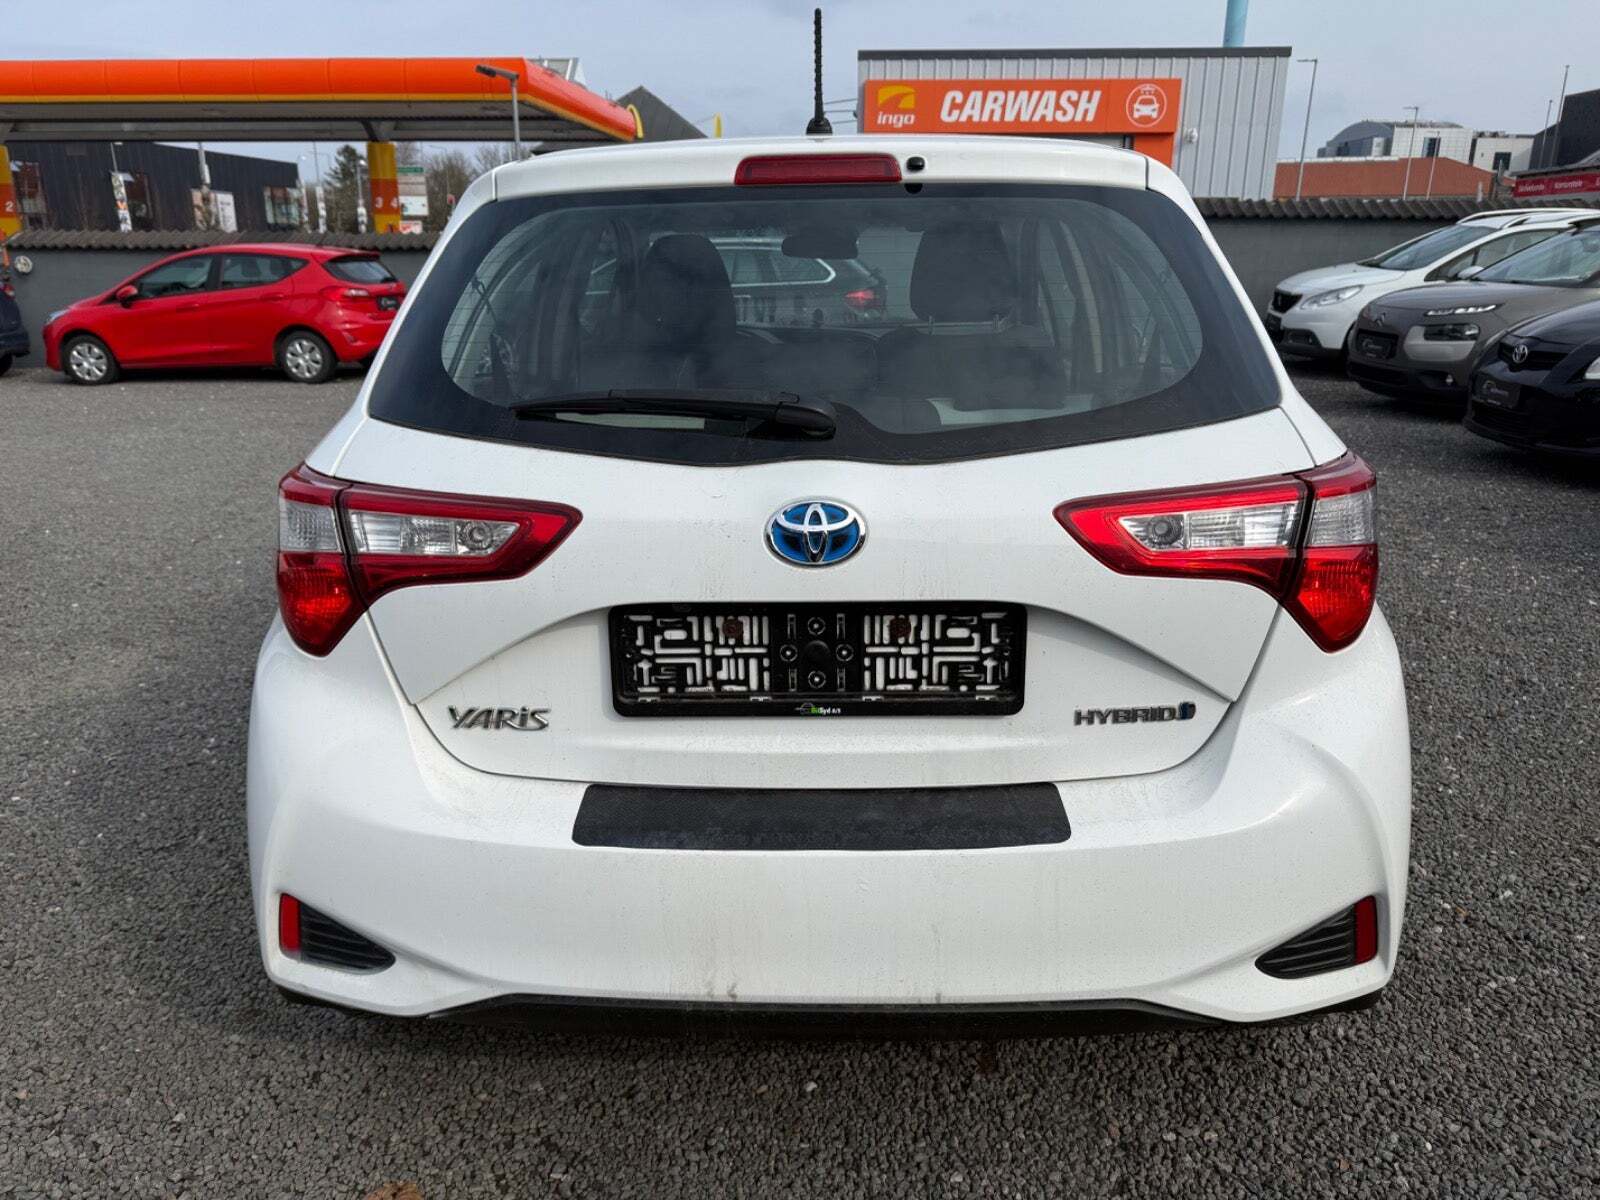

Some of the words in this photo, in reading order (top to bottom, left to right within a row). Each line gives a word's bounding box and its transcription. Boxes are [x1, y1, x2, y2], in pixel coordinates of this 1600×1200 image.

[940, 90, 1102, 123] CARWASH
[877, 111, 914, 128] ingo
[5, 200, 14, 212] 2
[1074, 706, 1177, 726] HYBRID
